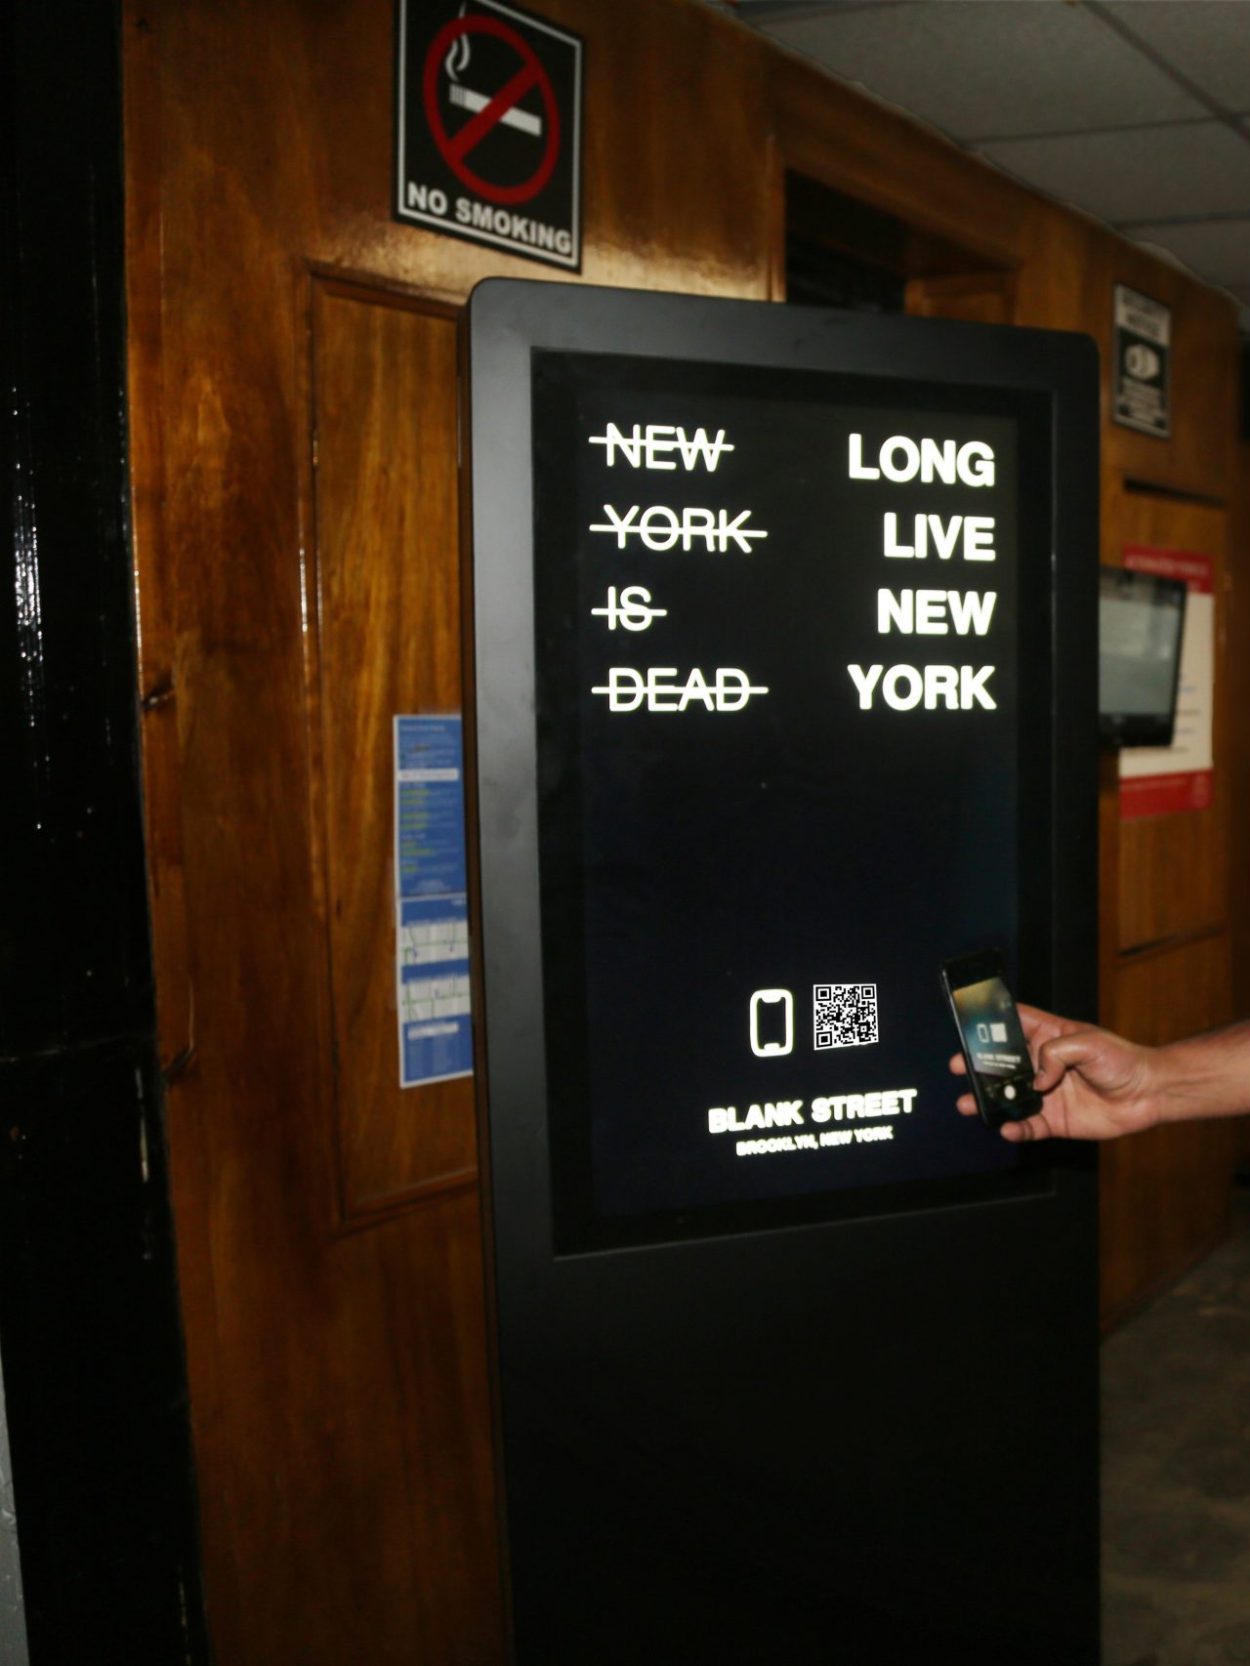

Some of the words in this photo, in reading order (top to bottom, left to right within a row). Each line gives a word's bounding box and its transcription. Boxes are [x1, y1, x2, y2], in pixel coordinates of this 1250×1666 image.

[406, 181, 448, 216] NO
[454, 197, 572, 255] SMOKING
[604, 422, 727, 473] NEW
[848, 432, 996, 488] LONG
[602, 503, 754, 554] YORK
[883, 511, 996, 562] LIVE
[604, 585, 656, 632] IS
[877, 588, 998, 636] NEW
[604, 667, 753, 712] DEAD
[846, 663, 998, 712] YORK
[707, 1100, 805, 1134] BLANK
[811, 1088, 918, 1123] STREET
[735, 1133, 819, 1157] BROOKLYN,
[819, 1129, 853, 1148] NEW
[853, 1125, 895, 1143] YORK
